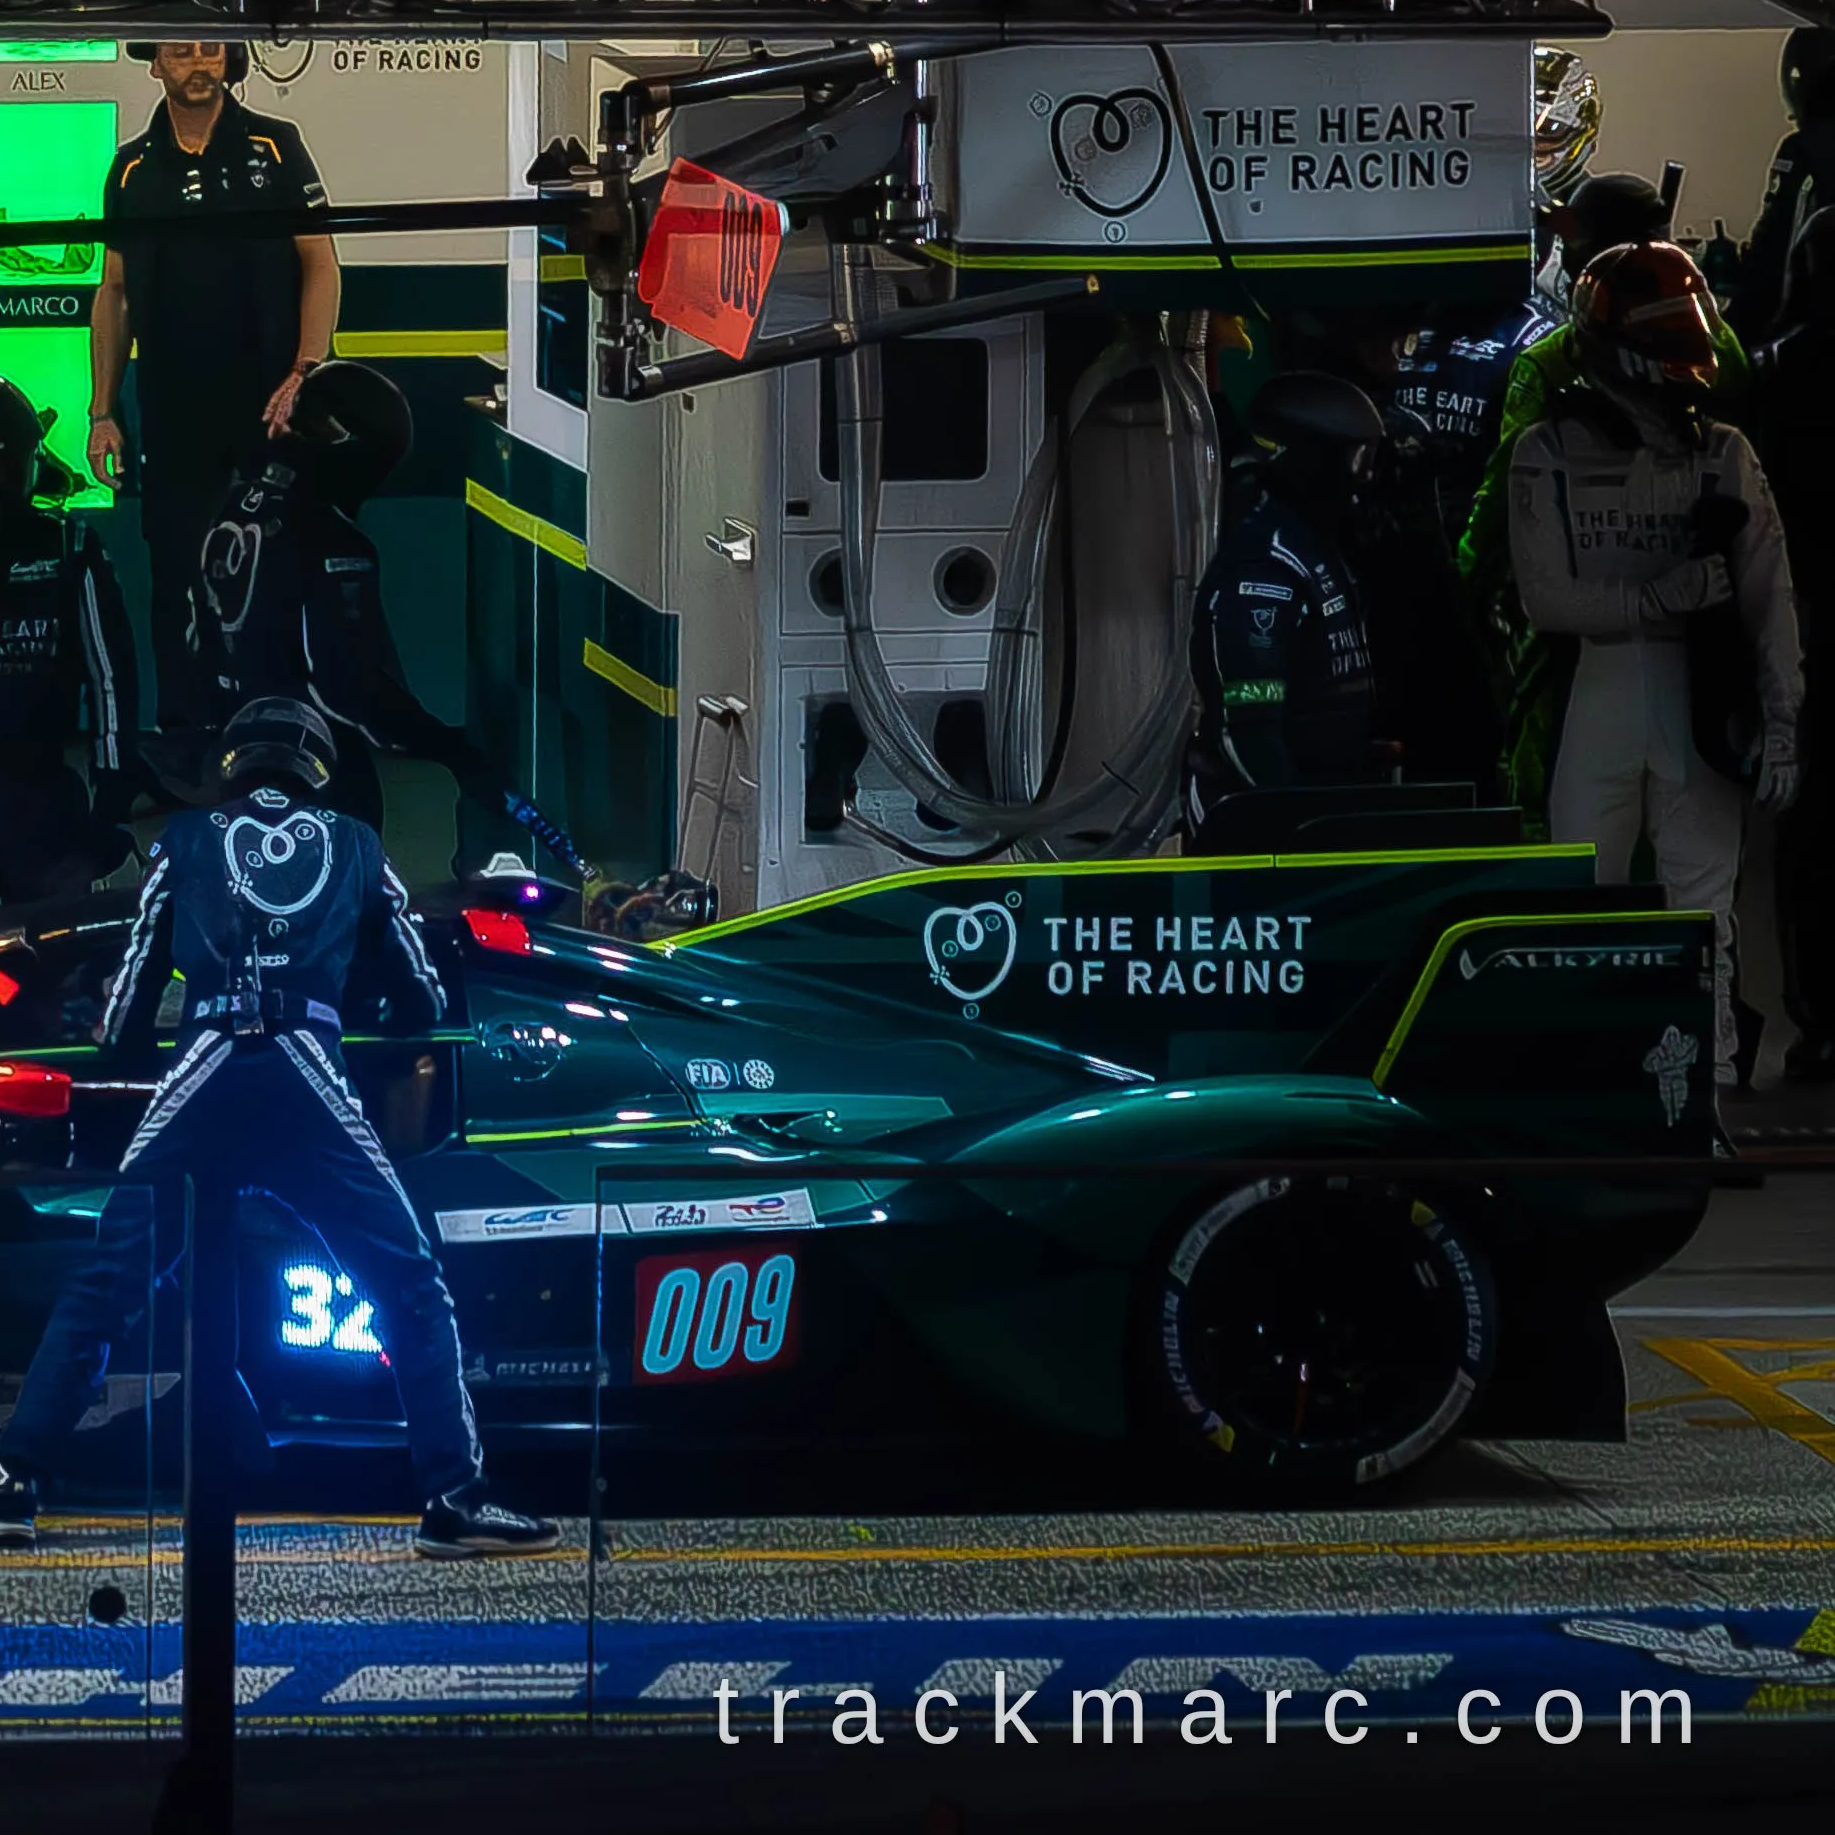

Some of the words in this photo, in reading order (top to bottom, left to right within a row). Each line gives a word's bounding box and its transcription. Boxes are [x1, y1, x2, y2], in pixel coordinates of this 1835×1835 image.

[333, 50, 367, 70] OF
[378, 49, 481, 71] RACING
[11, 72, 65, 91] ALEX
[1202, 108, 1297, 148] THE
[1320, 102, 1476, 146] HEART
[1209, 156, 1268, 192] OF
[1291, 149, 1470, 191] RACING
[1043, 917, 1133, 952] THE
[1156, 914, 1314, 952] HEART
[1047, 960, 1105, 996] OF
[1127, 957, 1307, 996] RACING
[642, 1253, 795, 1375] 009
